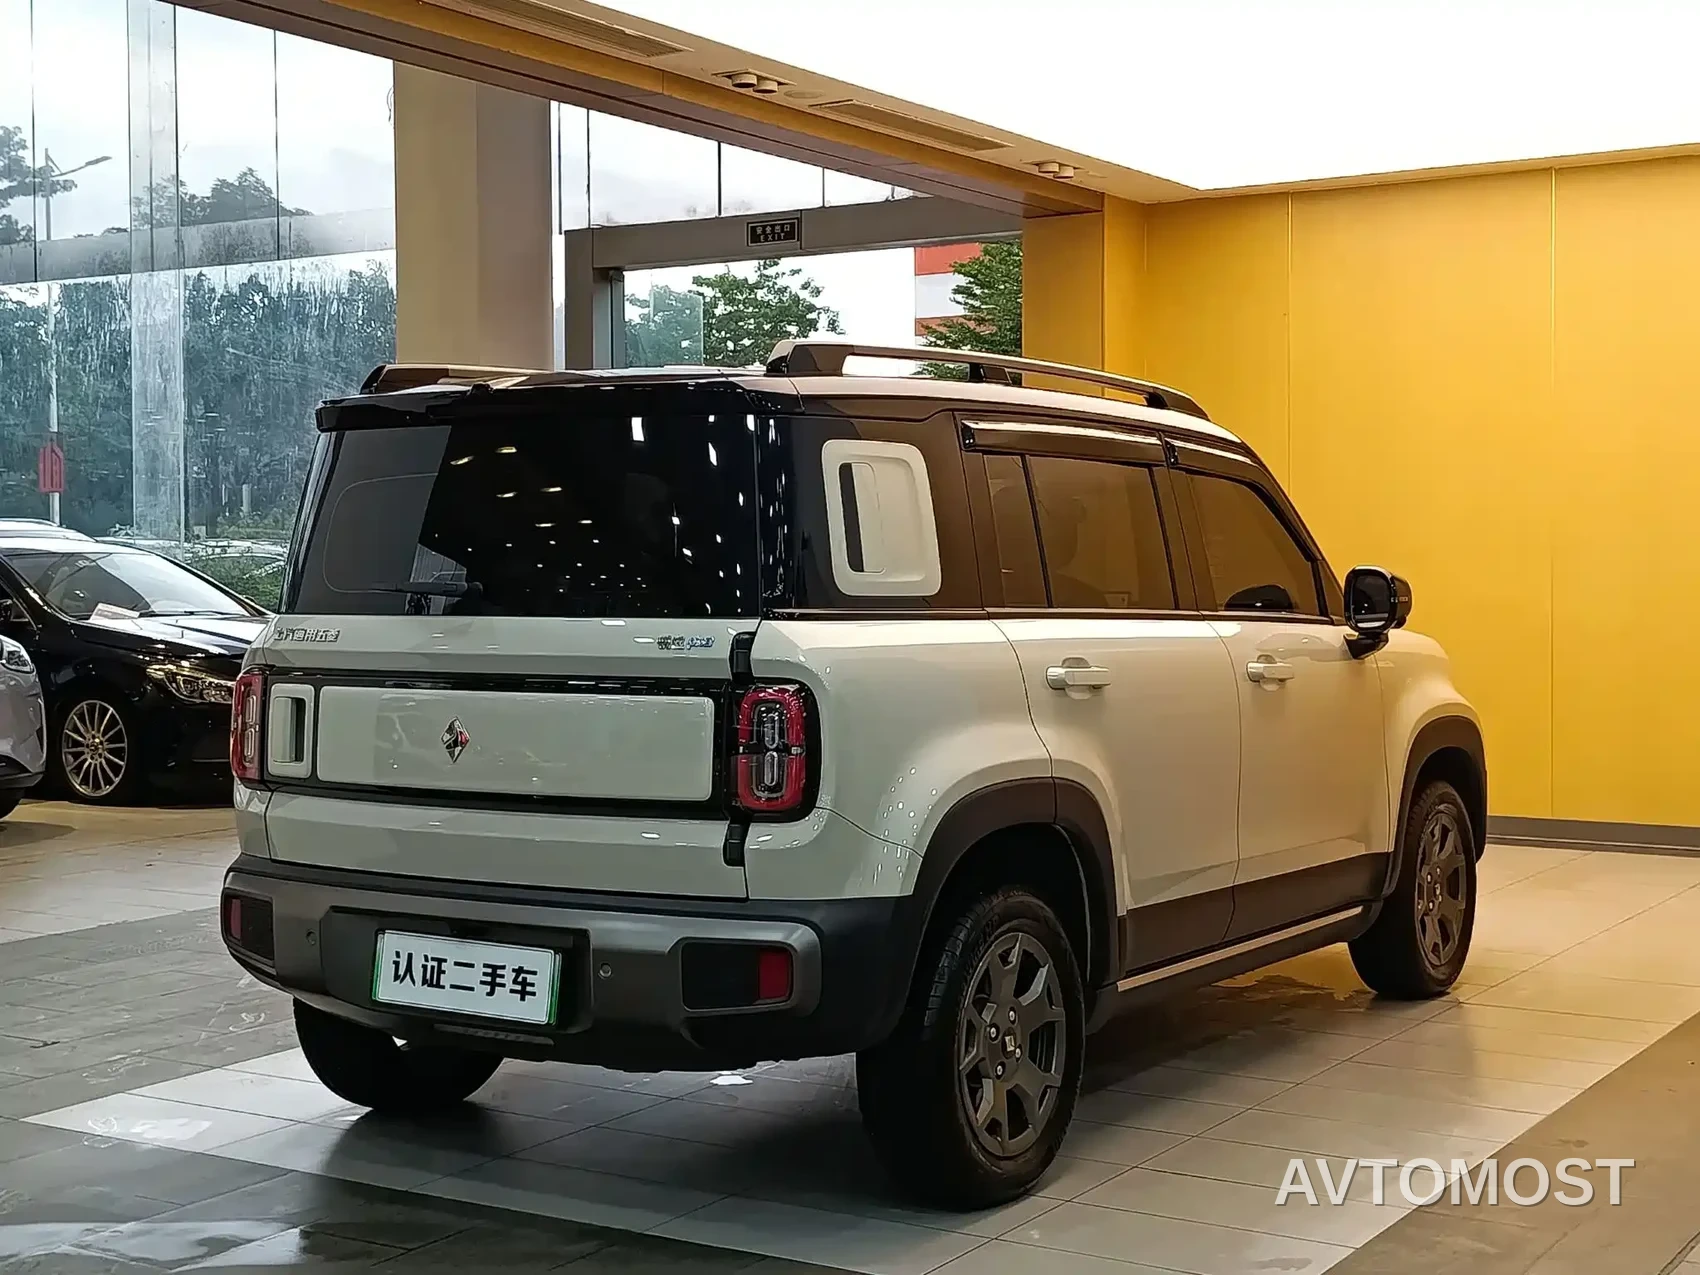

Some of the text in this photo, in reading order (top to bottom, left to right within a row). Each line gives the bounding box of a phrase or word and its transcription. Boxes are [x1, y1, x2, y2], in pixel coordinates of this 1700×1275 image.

[756, 224, 790, 235] 安全出口
[760, 233, 785, 242] EXIT
[392, 950, 538, 1002] 认证二手车
